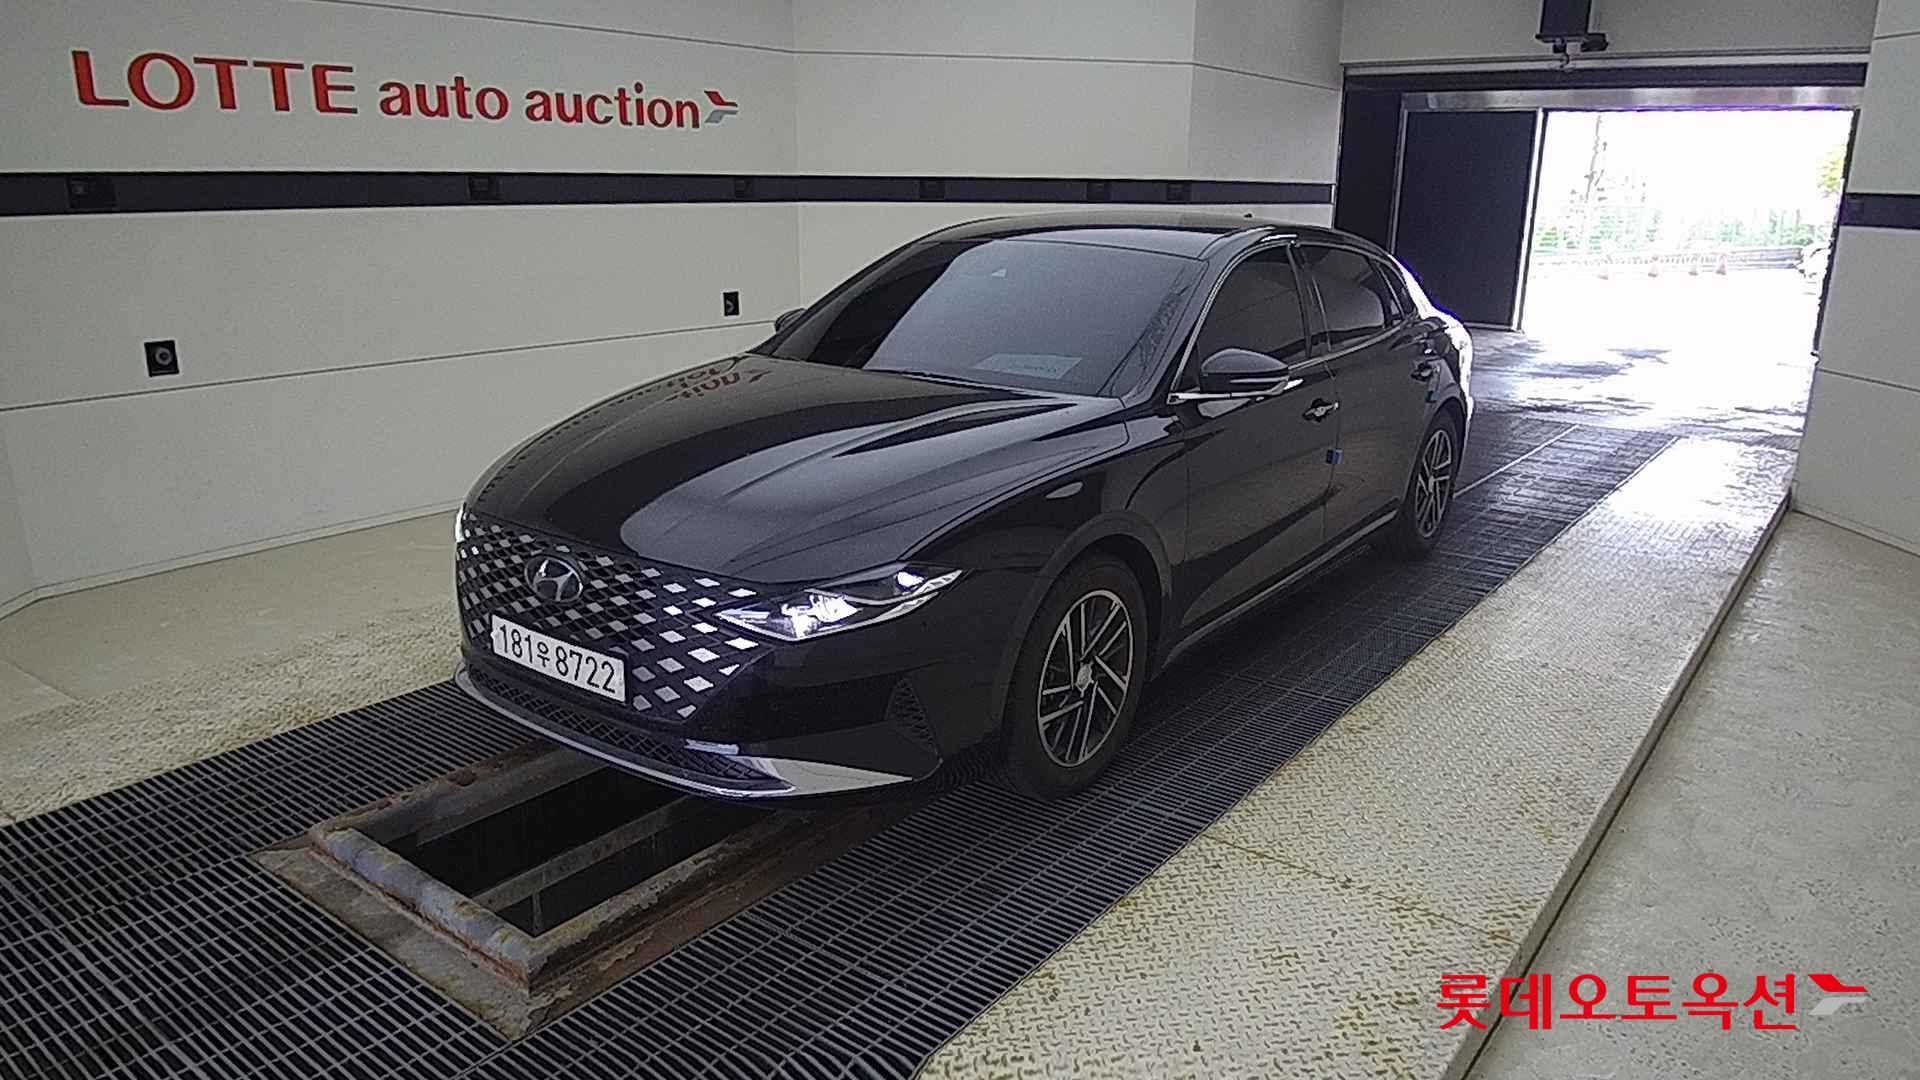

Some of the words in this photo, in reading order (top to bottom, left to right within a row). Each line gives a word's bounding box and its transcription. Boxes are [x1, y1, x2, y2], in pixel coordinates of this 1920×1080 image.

[74, 50, 358, 114] LOTTE
[381, 76, 510, 121] auto
[526, 81, 701, 130] auction
[500, 624, 615, 694] 181우8722
